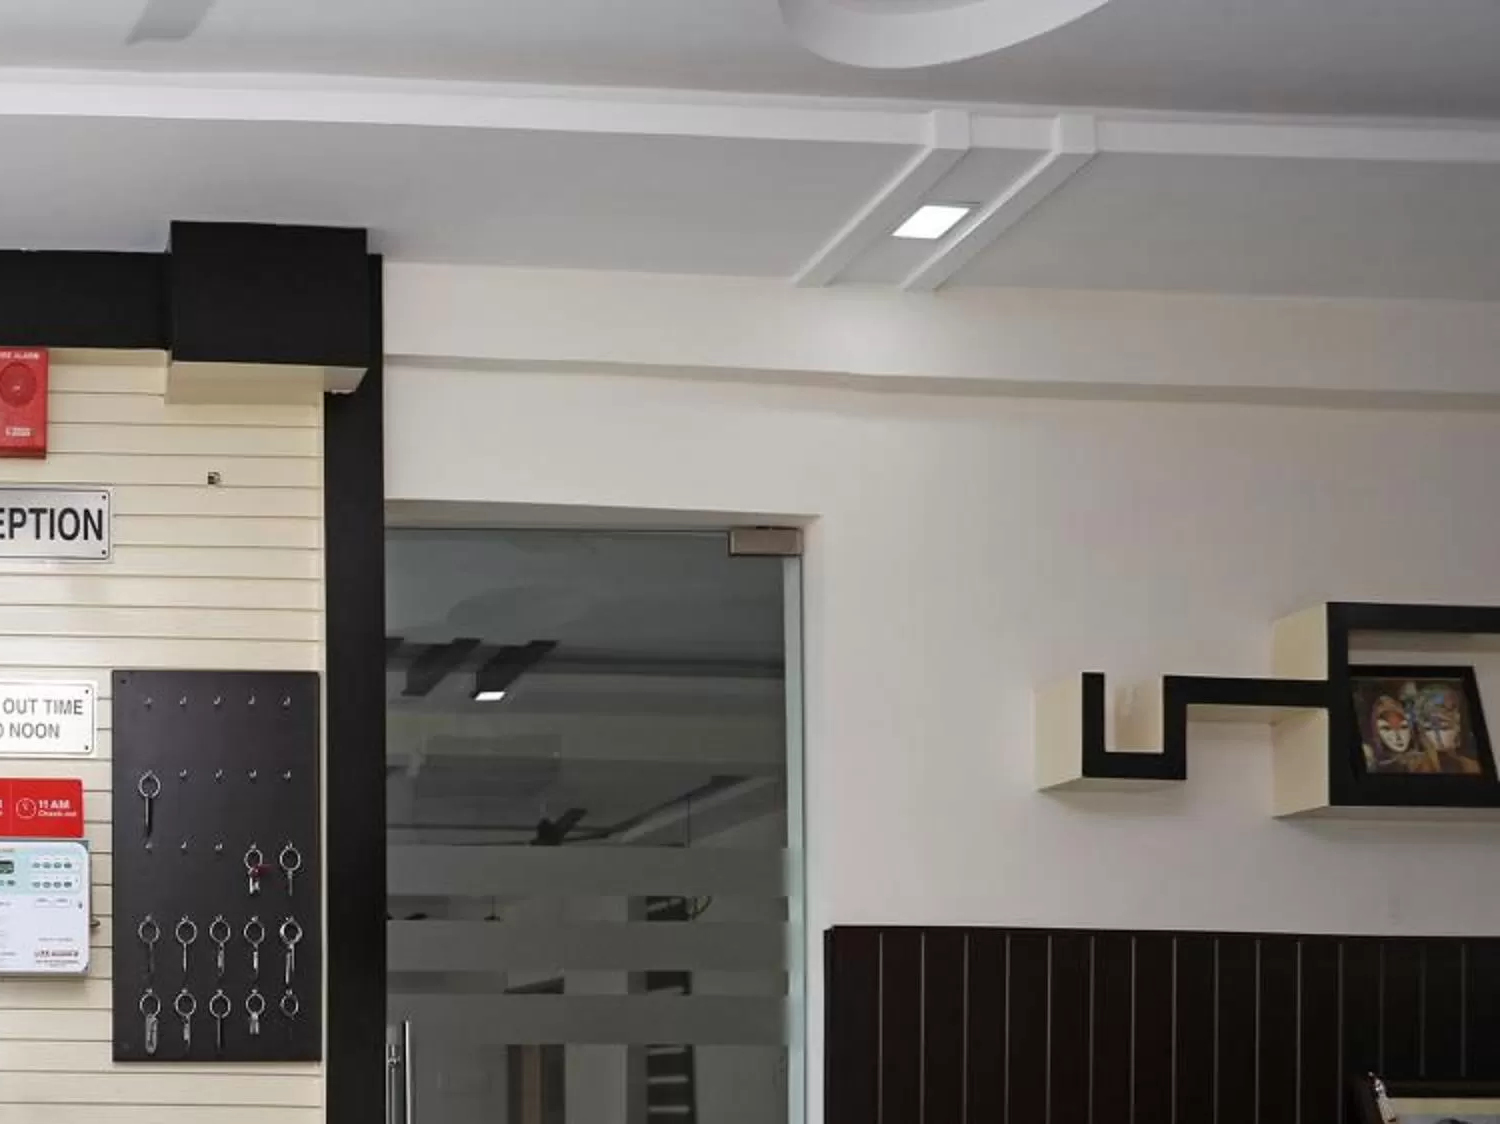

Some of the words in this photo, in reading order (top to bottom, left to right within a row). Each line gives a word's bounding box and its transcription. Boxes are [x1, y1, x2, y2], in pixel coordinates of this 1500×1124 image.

[2, 697, 37, 715] OUT
[44, 698, 84, 716] TIME
[9, 722, 60, 739] NOON
[38, 799, 49, 809] 11
[50, 799, 70, 809] AM
